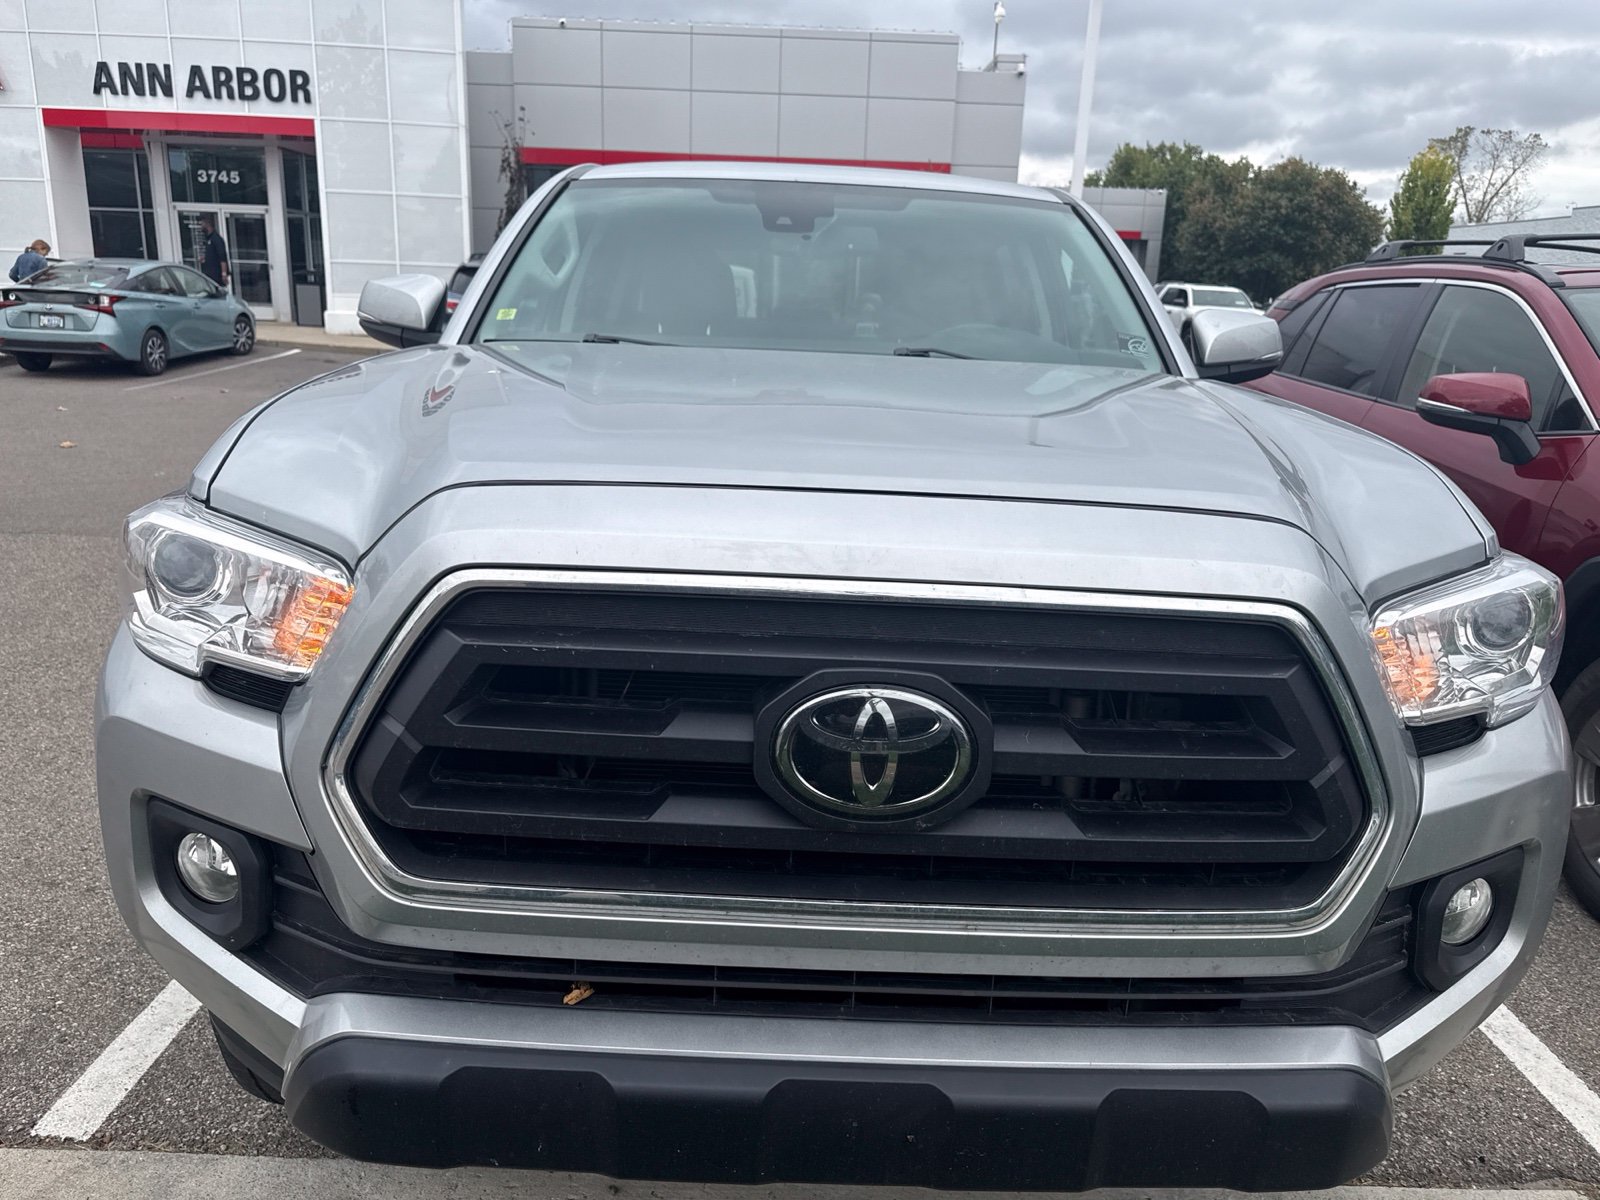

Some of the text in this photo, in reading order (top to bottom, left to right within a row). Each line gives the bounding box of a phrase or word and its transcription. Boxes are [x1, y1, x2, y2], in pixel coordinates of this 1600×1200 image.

[93, 61, 312, 103] ANN ARBOR
[197, 170, 240, 184] 3745
